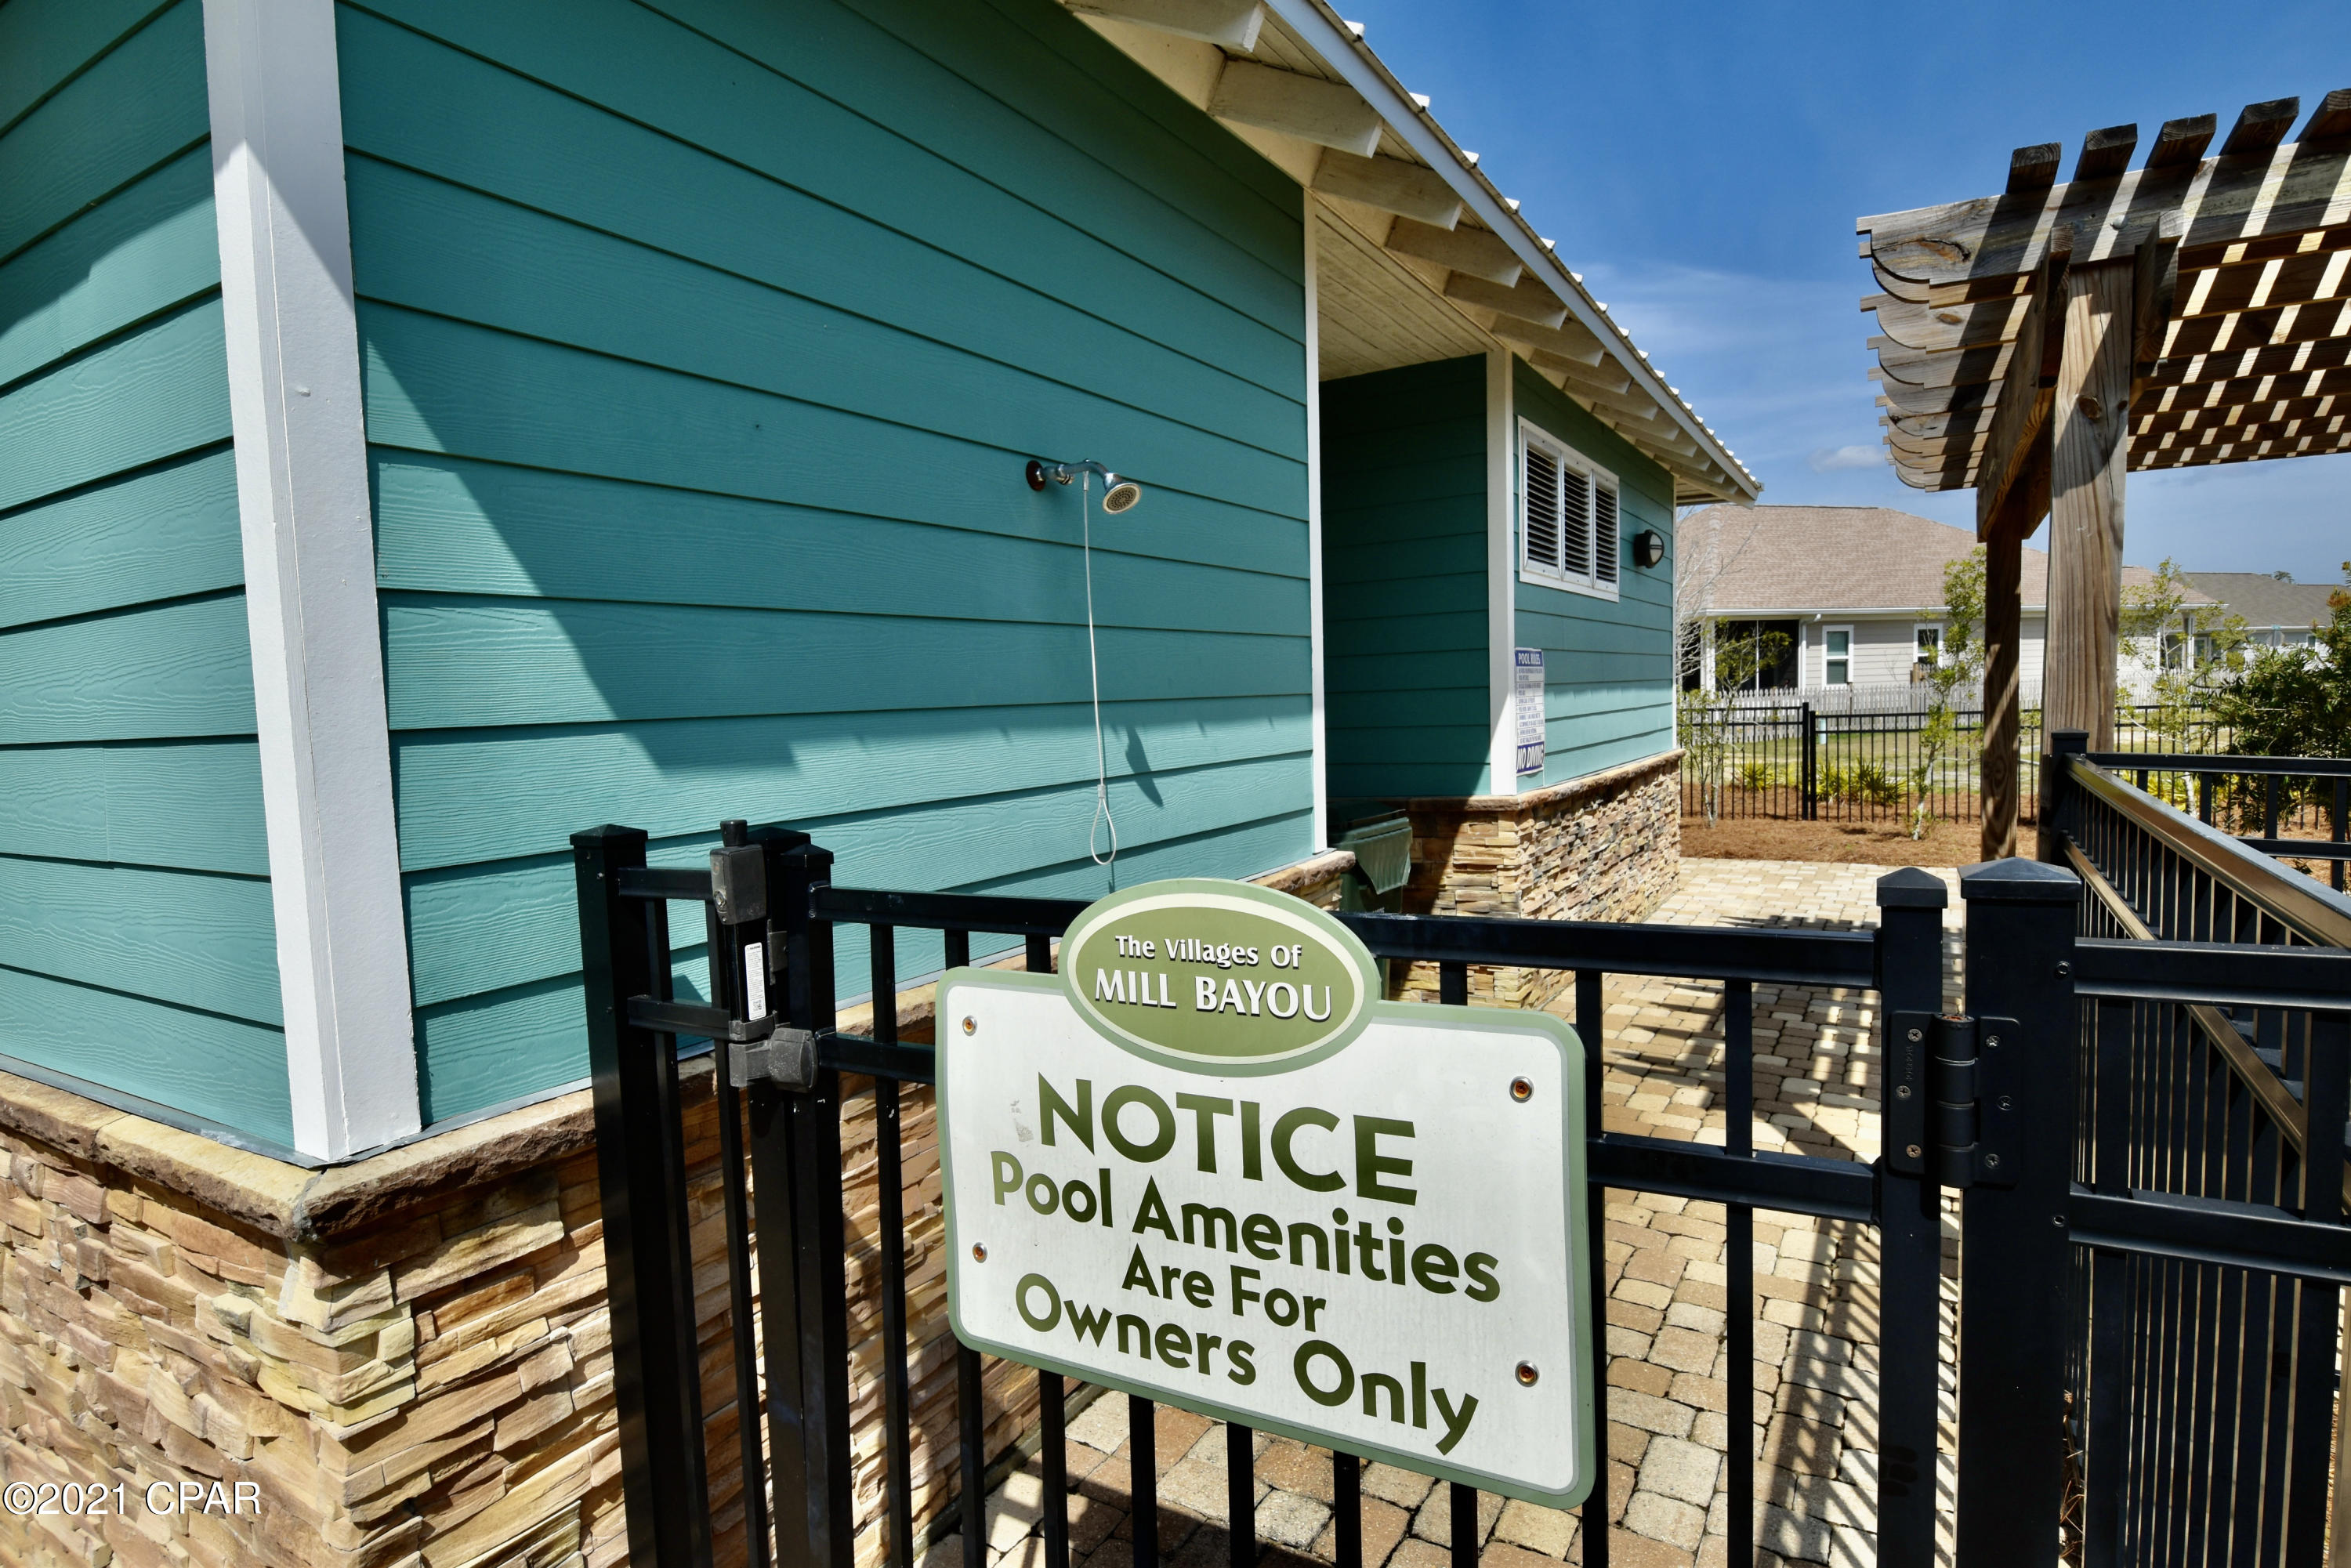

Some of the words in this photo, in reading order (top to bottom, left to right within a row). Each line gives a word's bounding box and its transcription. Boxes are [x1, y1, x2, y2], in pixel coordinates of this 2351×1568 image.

[1518, 653, 1531, 664] POOL
[1516, 747, 1527, 770] NO
[1115, 934, 1156, 958] The
[1165, 938, 1259, 968] Villages
[1270, 944, 1302, 969] Of
[1095, 969, 1177, 1009] MILL
[1195, 976, 1332, 1021] BAYOU
[1038, 1072, 1418, 1208] NOTICE
[990, 1150, 1114, 1229] Pool
[1132, 1175, 1501, 1303] Amenities
[1121, 1242, 1215, 1309] Are
[1230, 1264, 1328, 1334] For
[1015, 1273, 1258, 1387] Owners
[1293, 1339, 1480, 1457] Only
